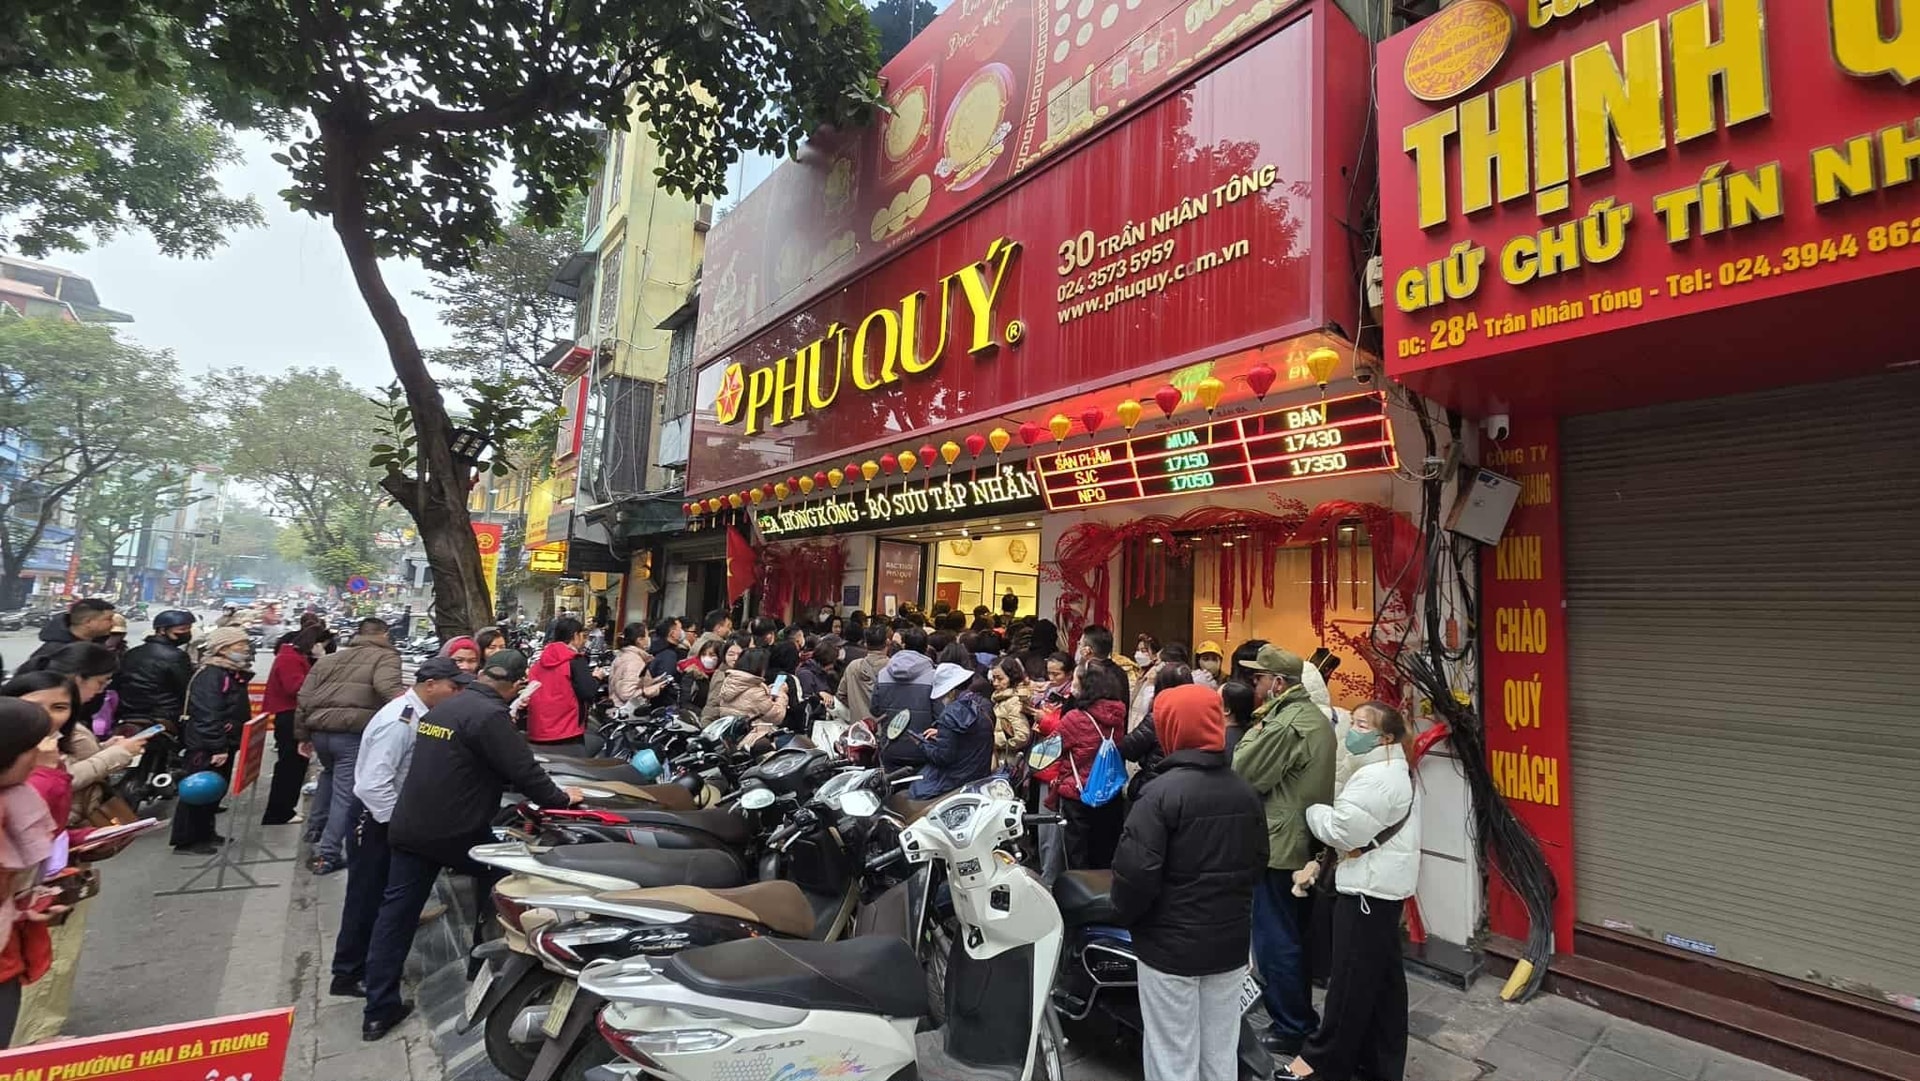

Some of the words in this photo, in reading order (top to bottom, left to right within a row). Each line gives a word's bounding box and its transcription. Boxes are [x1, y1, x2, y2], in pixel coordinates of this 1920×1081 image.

[1403, 0, 1771, 229] THỊNH
[1058, 230, 1095, 275] 30
[1097, 220, 1145, 259] TRẦN
[1151, 193, 1208, 236] NHÂN
[1212, 164, 1277, 208] TÔNG
[1395, 240, 1486, 313] GIỮ
[1500, 195, 1634, 285] CHỮ
[1653, 160, 1784, 243] TÍN
[1056, 279, 1084, 303] 024
[1088, 259, 1127, 291] 3573
[1130, 238, 1175, 274] 5959
[1531, 300, 1584, 331] Nhân
[1588, 286, 1643, 315] Tông
[1666, 268, 1712, 298] Tel:
[1718, 234, 1860, 287] 024.3944
[744, 322, 849, 435] PHÚ
[852, 236, 1021, 391] QUÝ
[1287, 406, 1325, 429] BÁN
[1165, 431, 1199, 449] MUA
[1284, 428, 1342, 453] 17430
[1529, 444, 1548, 463] TY
[1074, 471, 1100, 486] SJC
[1165, 452, 1210, 472] 17150
[1169, 471, 1215, 491] 17050
[1290, 452, 1348, 476] 17350
[869, 493, 892, 521] BỘ
[930, 481, 967, 513] TẬP
[1077, 487, 1106, 503] NPQ
[1496, 528, 1542, 580] KÍNH
[1496, 600, 1547, 654] CHÀO
[1504, 672, 1542, 731] QUÝ
[417, 721, 455, 741] ECURITY
[1492, 745, 1559, 806] KHÁCH
[1238, 977, 1259, 1013] .62
[48, 1053, 134, 1081] PHƯỜNG
[139, 1048, 173, 1066] HAI
[178, 1039, 203, 1058] BÀ
[210, 1031, 270, 1054] TRƯNG
